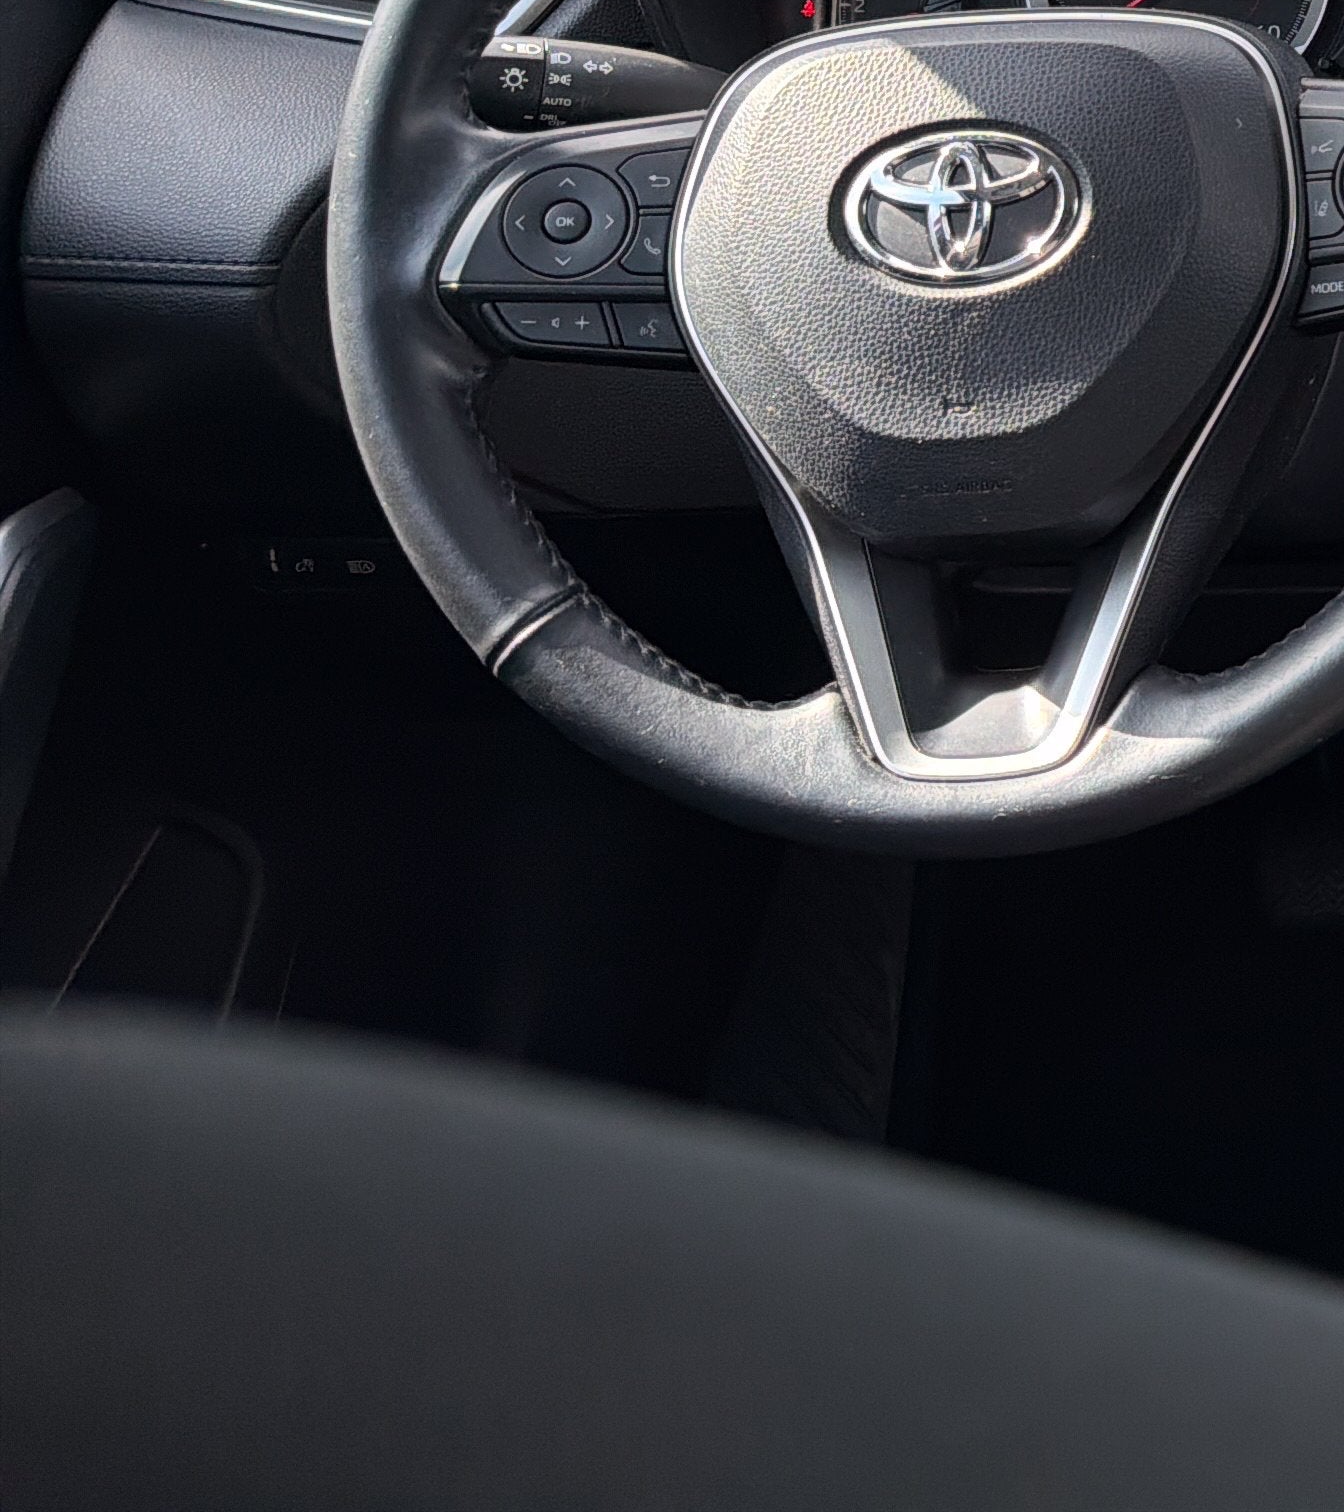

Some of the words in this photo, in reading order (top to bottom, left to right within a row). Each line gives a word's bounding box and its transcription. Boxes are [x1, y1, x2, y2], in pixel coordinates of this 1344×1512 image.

[541, 97, 572, 106] AUTO
[555, 216, 575, 227] OK
[1311, 281, 1344, 294] MODE
